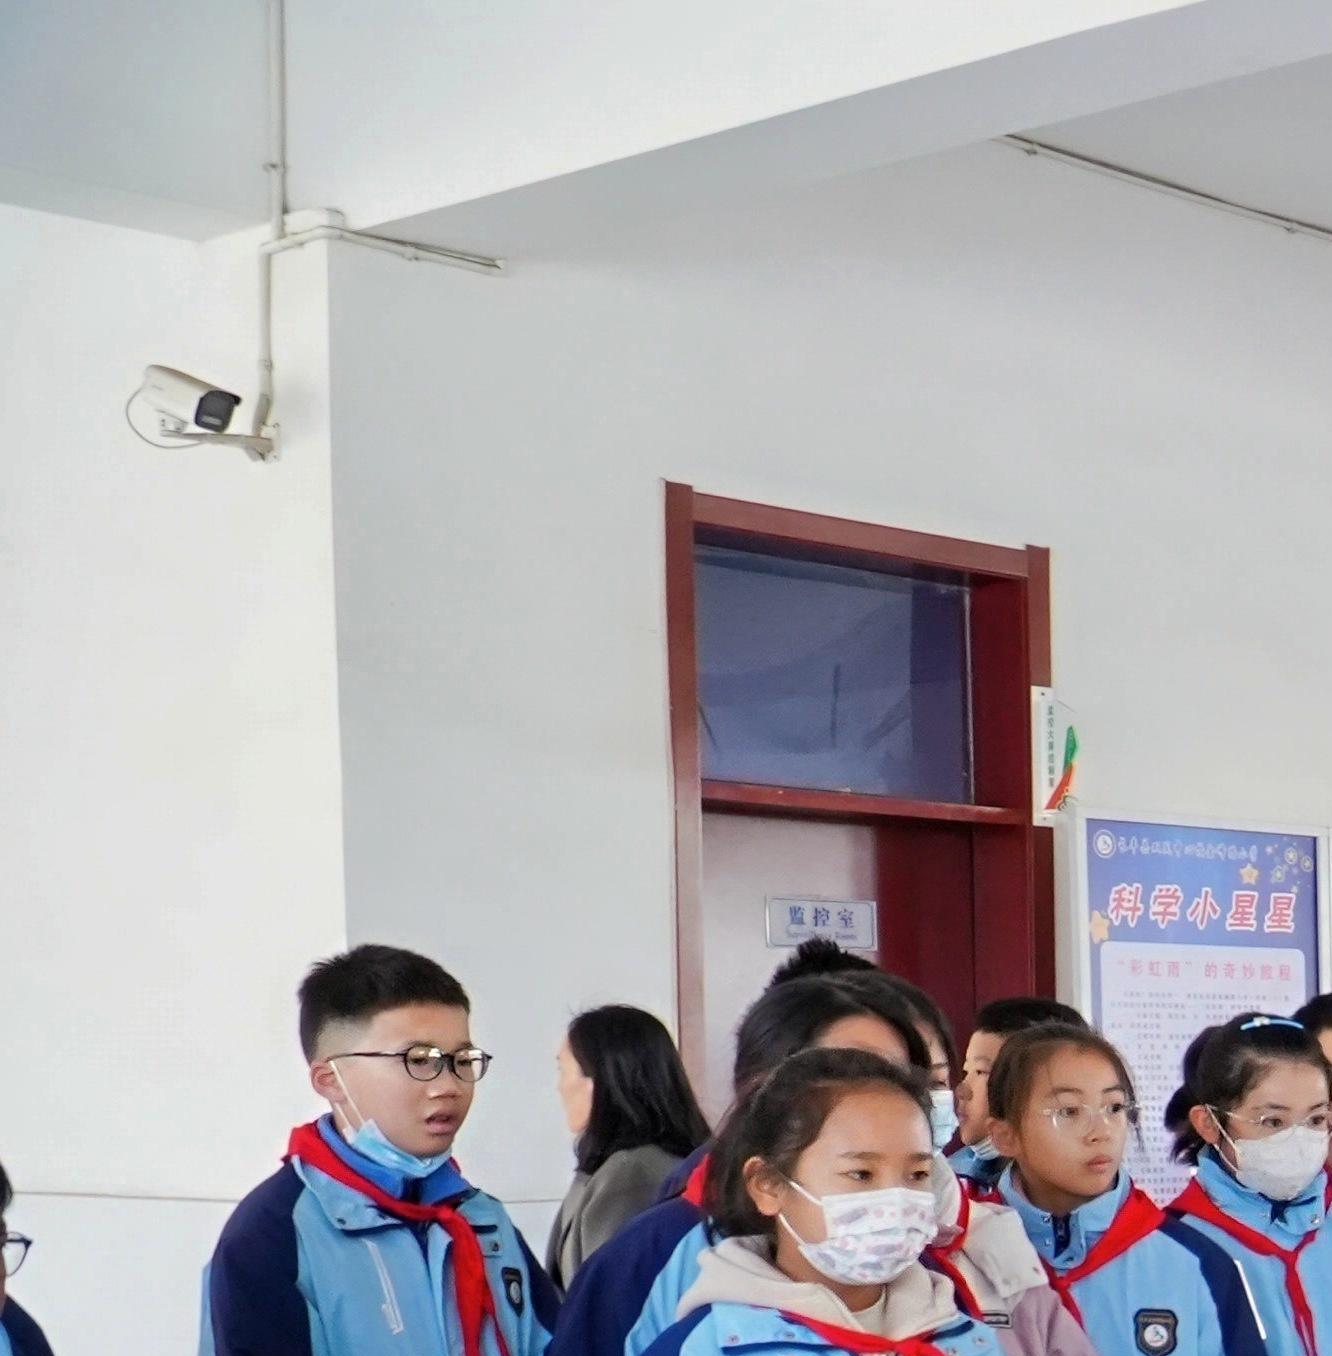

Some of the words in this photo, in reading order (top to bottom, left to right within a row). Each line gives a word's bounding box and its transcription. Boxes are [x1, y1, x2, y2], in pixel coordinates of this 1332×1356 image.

[789, 905, 855, 928] 监控室
[1109, 883, 1297, 933] 科学小星星
